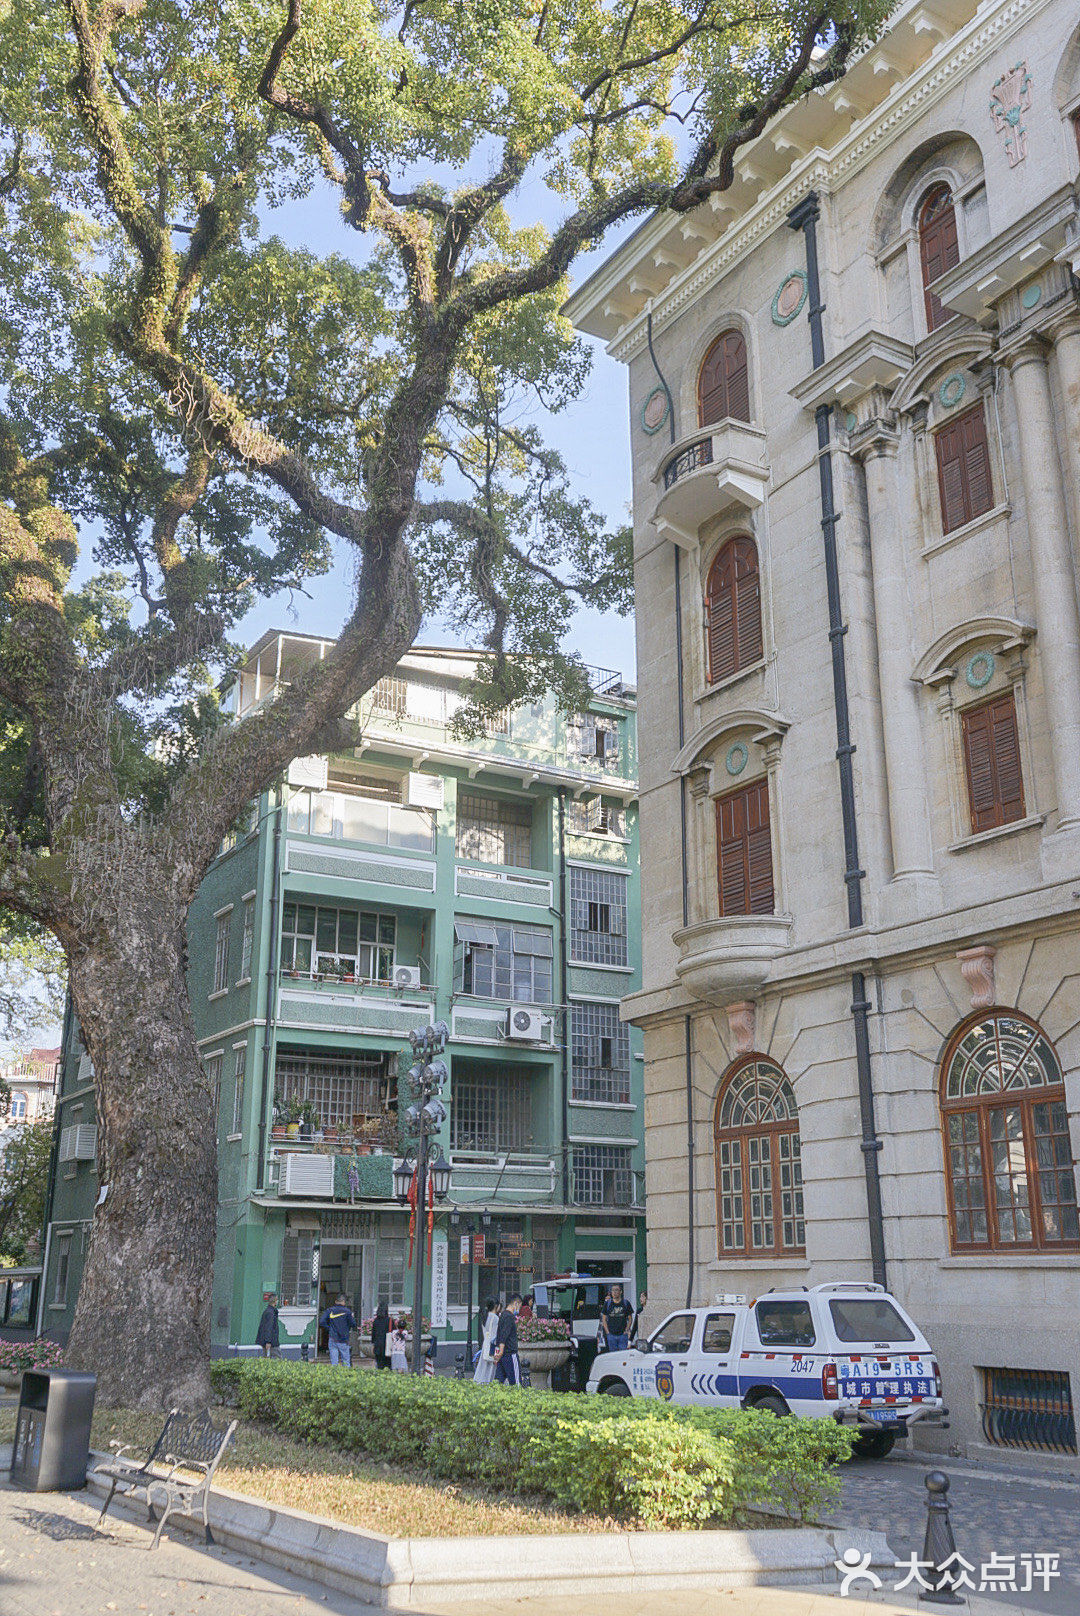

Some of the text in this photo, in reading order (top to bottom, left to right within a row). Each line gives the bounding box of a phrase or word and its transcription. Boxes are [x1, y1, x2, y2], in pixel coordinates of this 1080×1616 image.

[790, 1360, 815, 1373] 2047
[846, 1381, 927, 1395] 城市管理执法
